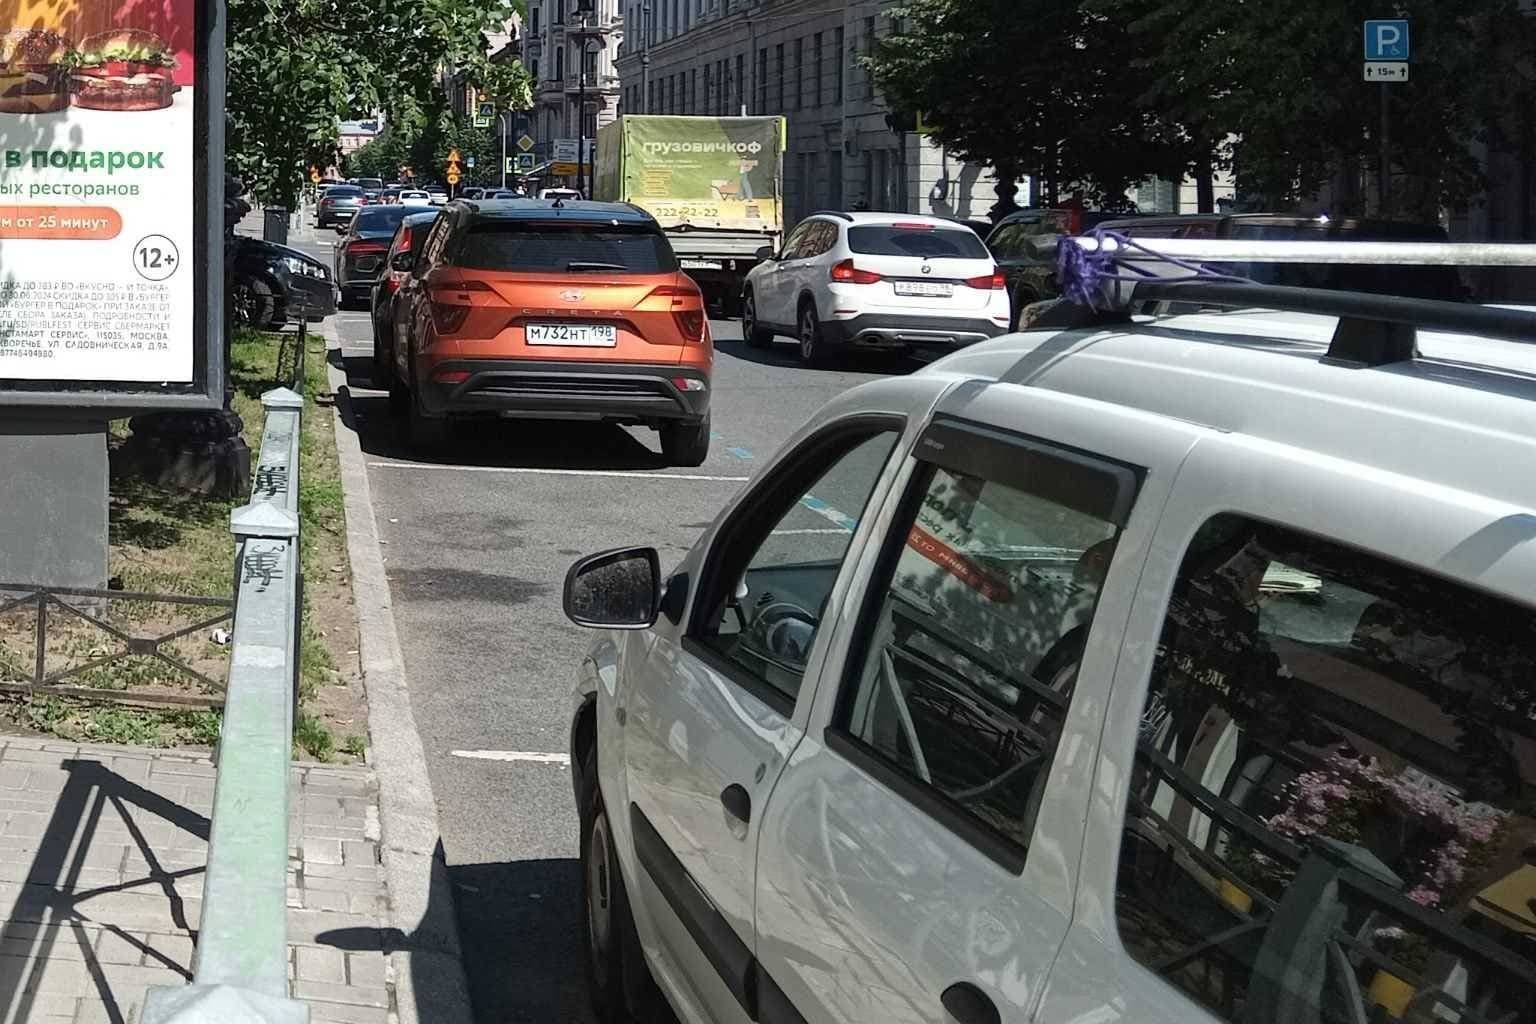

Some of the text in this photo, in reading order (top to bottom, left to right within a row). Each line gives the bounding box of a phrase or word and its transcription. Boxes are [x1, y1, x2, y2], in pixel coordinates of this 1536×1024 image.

[1377, 25, 1400, 55] P
[5, 150, 23, 168] в
[31, 150, 165, 175] подарок
[30, 182, 140, 198] ресторанов
[16, 217, 33, 228] от
[38, 215, 57, 228] 25
[60, 218, 108, 230] минут
[139, 247, 175, 268] 12+
[520, 308, 624, 316] CRETA
[591, 326, 613, 339] 198
